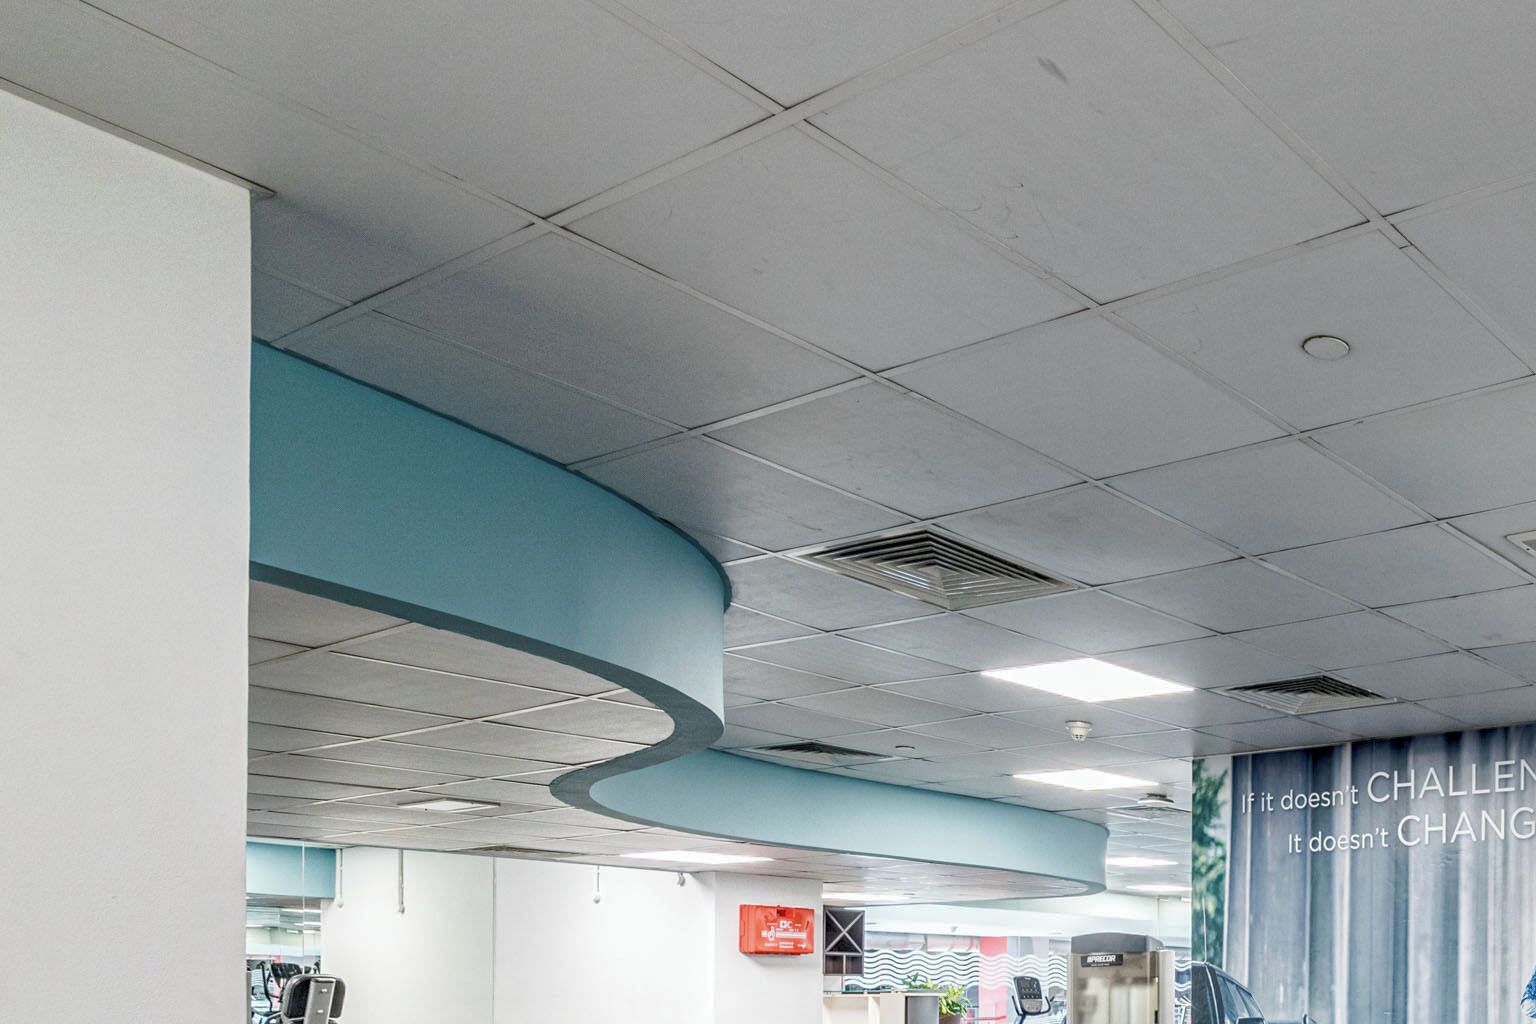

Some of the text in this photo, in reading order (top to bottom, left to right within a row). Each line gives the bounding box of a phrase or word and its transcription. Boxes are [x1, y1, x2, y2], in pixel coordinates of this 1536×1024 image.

[1242, 793, 1254, 813] If
[1261, 792, 1274, 812] it
[1280, 785, 1359, 810] doesn't
[1288, 833, 1302, 853] It
[1309, 827, 1389, 852] doesn't
[1090, 955, 1116, 963] PRECOR
